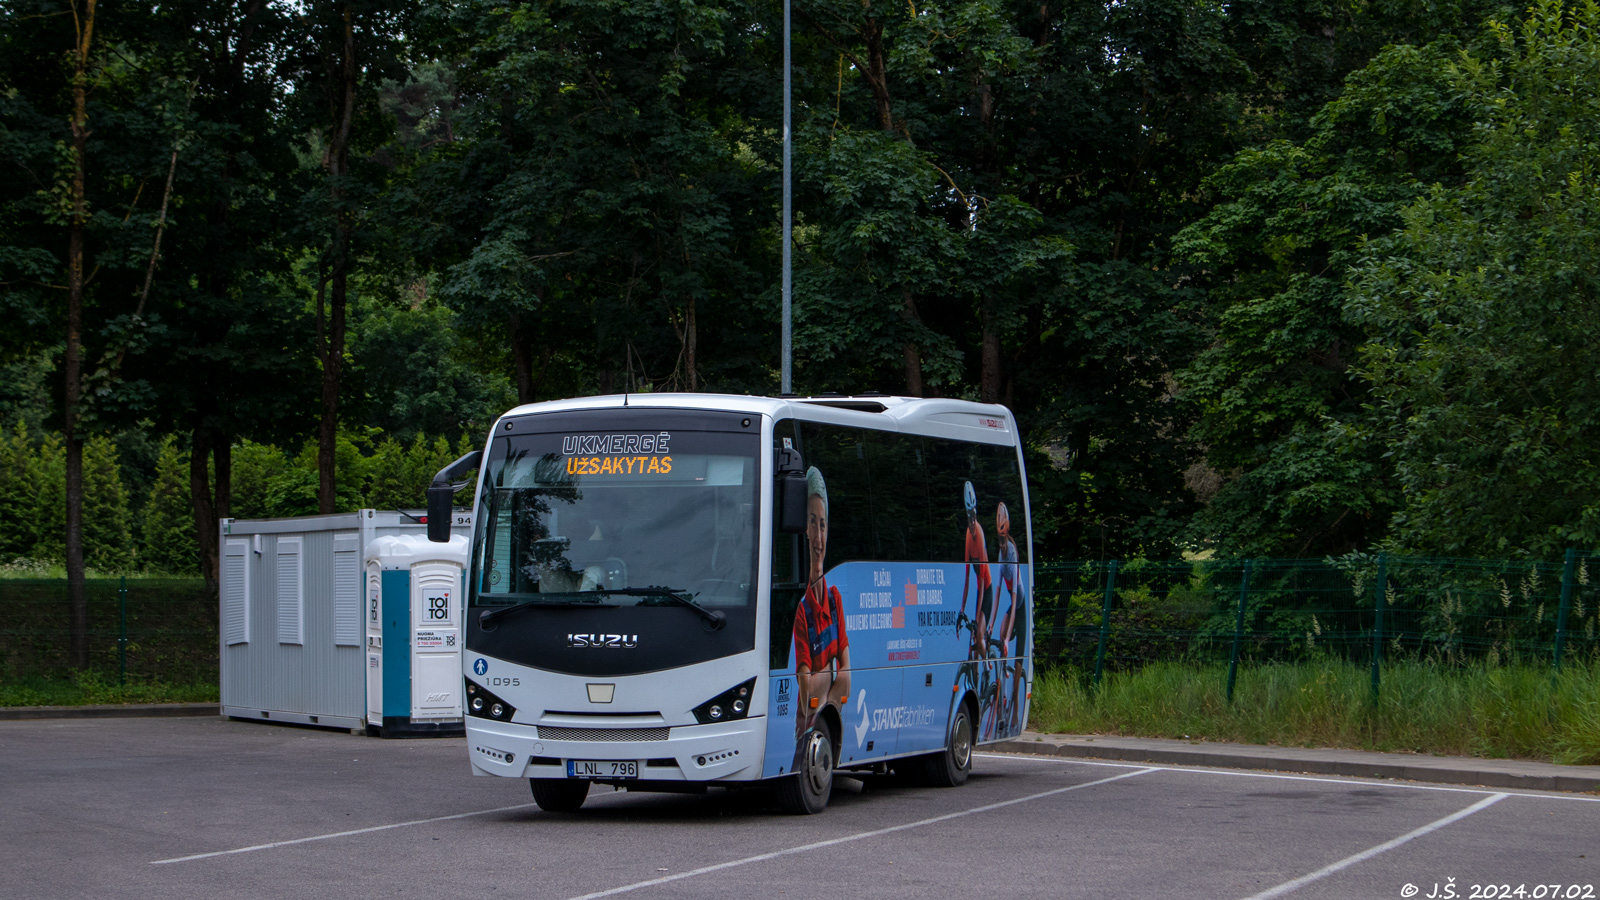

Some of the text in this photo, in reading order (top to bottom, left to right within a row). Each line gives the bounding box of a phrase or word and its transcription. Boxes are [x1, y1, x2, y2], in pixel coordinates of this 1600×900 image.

[562, 431, 671, 455] UKMERGĖ
[566, 455, 673, 475] UŽSAKYTAS
[916, 568, 936, 585] DIRBKITE
[428, 595, 449, 609] TOI
[859, 592, 893, 609] ATVERIA DURIS
[917, 589, 943, 605] KUR DARBAS
[428, 608, 449, 620] TOI
[869, 613, 893, 630] KOLEGOMS
[917, 612, 926, 627] YRA
[926, 612, 933, 627] NE
[940, 611, 956, 626] DARBAS
[567, 634, 638, 649] ISUZU
[485, 677, 521, 687] 1095
[778, 678, 790, 694] AP
[776, 704, 788, 717] 1095
[871, 704, 935, 732] STANSEfabrikken
[575, 762, 635, 776] LNL 796
